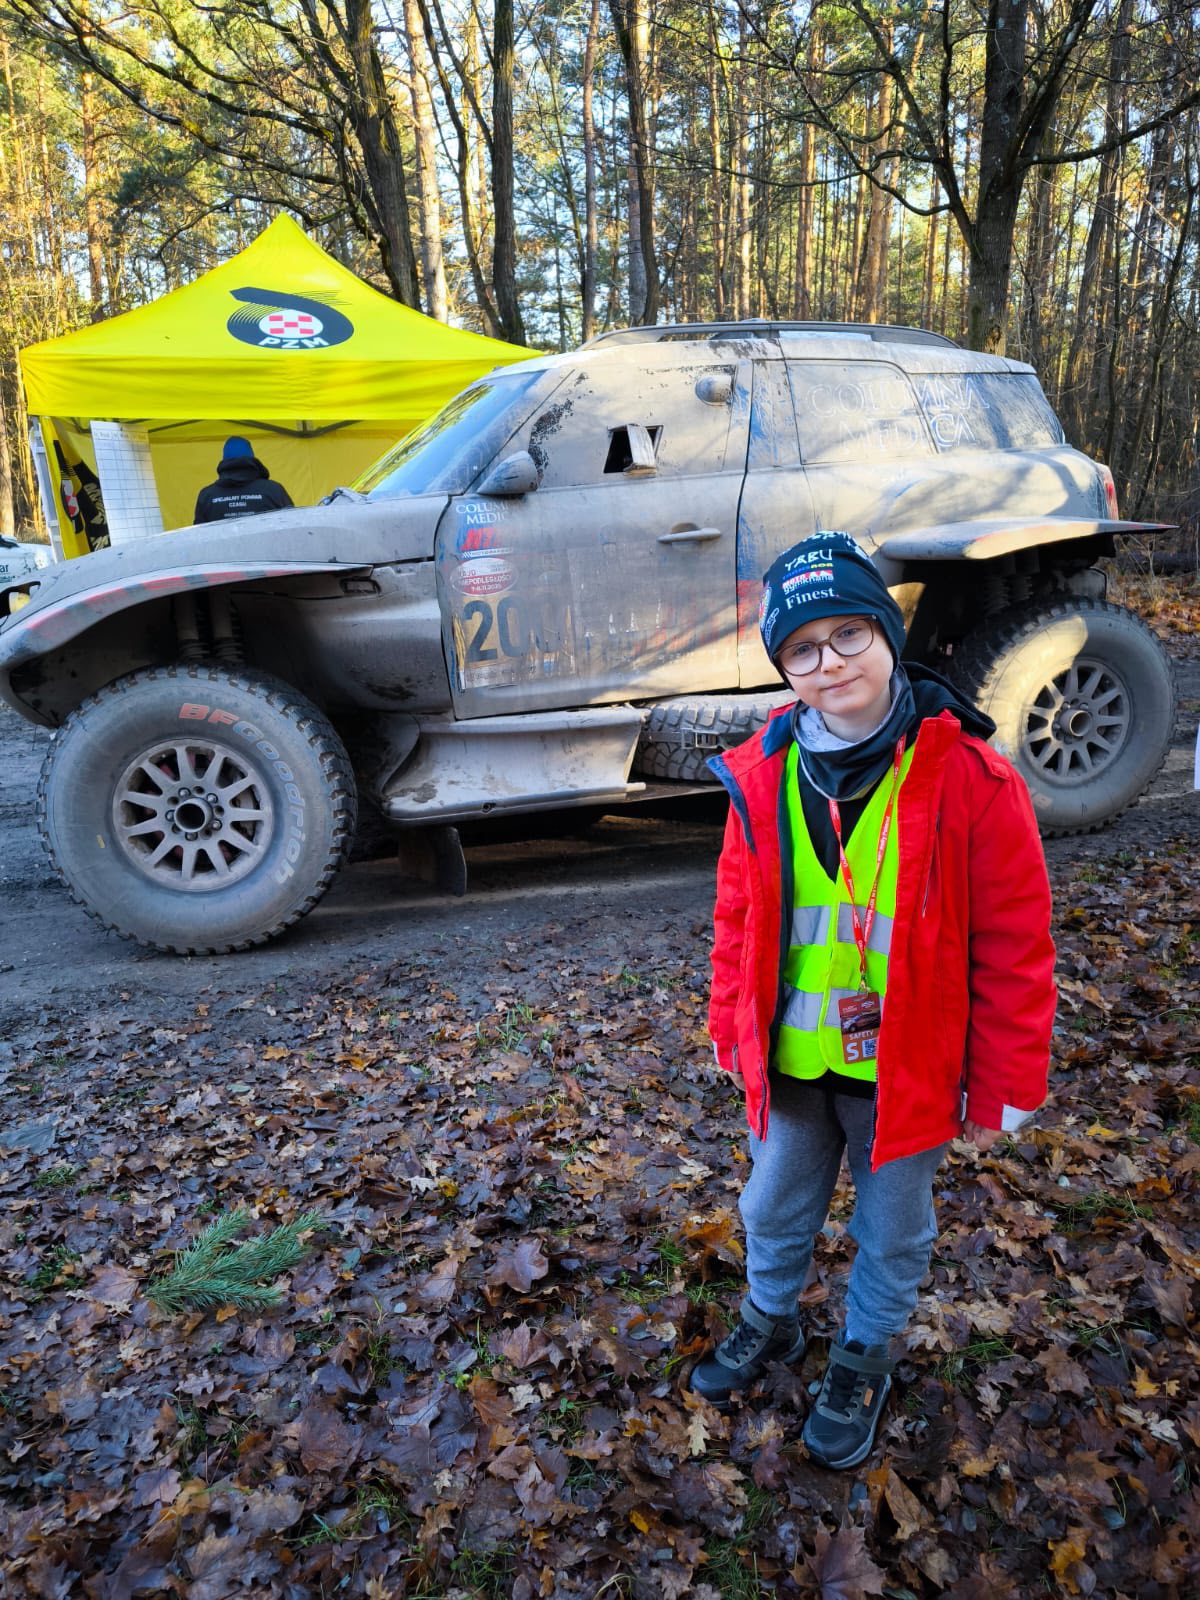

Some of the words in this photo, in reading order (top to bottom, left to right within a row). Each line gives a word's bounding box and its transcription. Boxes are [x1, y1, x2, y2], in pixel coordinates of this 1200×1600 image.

[258, 337, 330, 349] PZM
[805, 377, 990, 418] COLUMNA
[838, 412, 978, 455] MEDICA
[785, 549, 833, 571] YABU
[848, 1030, 874, 1040] SAFETY
[846, 1042, 859, 1061] S
